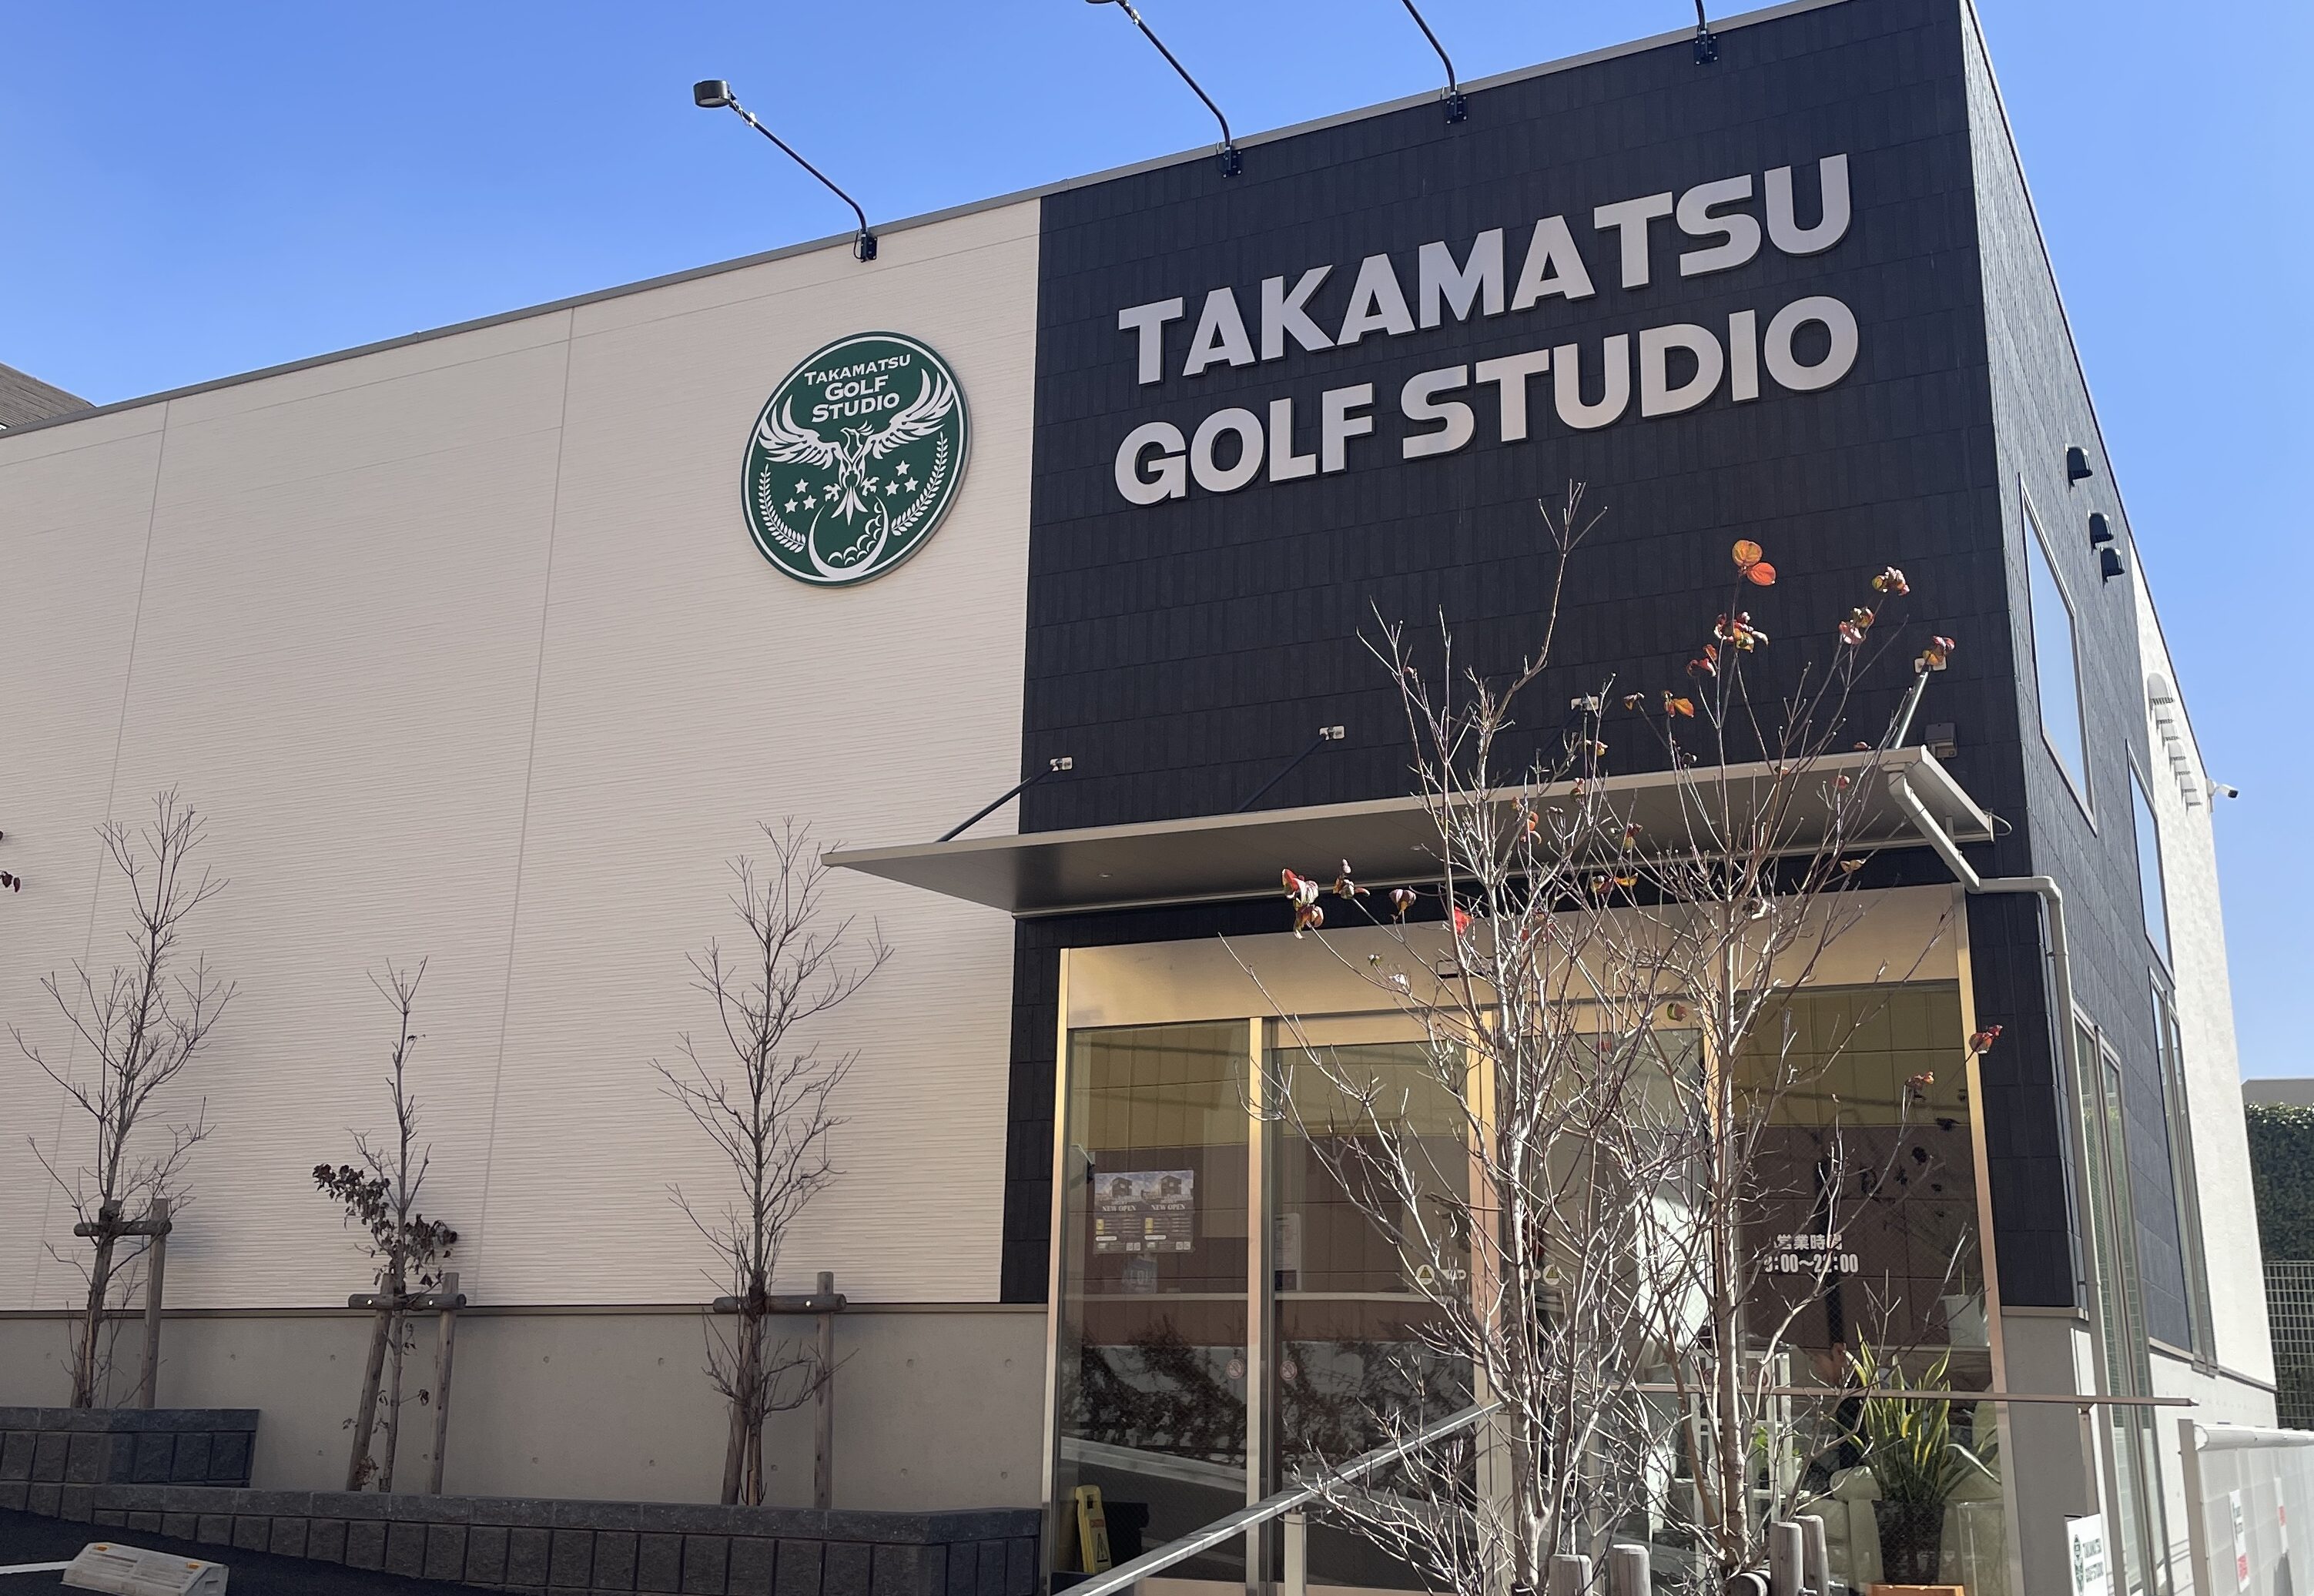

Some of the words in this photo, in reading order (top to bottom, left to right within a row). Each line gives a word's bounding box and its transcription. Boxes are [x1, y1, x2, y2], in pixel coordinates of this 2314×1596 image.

[1118, 153, 1850, 385] TAKAMATSU
[804, 353, 911, 386] TAKAMATSU
[825, 374, 889, 401] GOLF
[1114, 382, 1373, 505] GOLF
[1401, 296, 1858, 459] STUDIO
[811, 392, 900, 423] STUDIO
